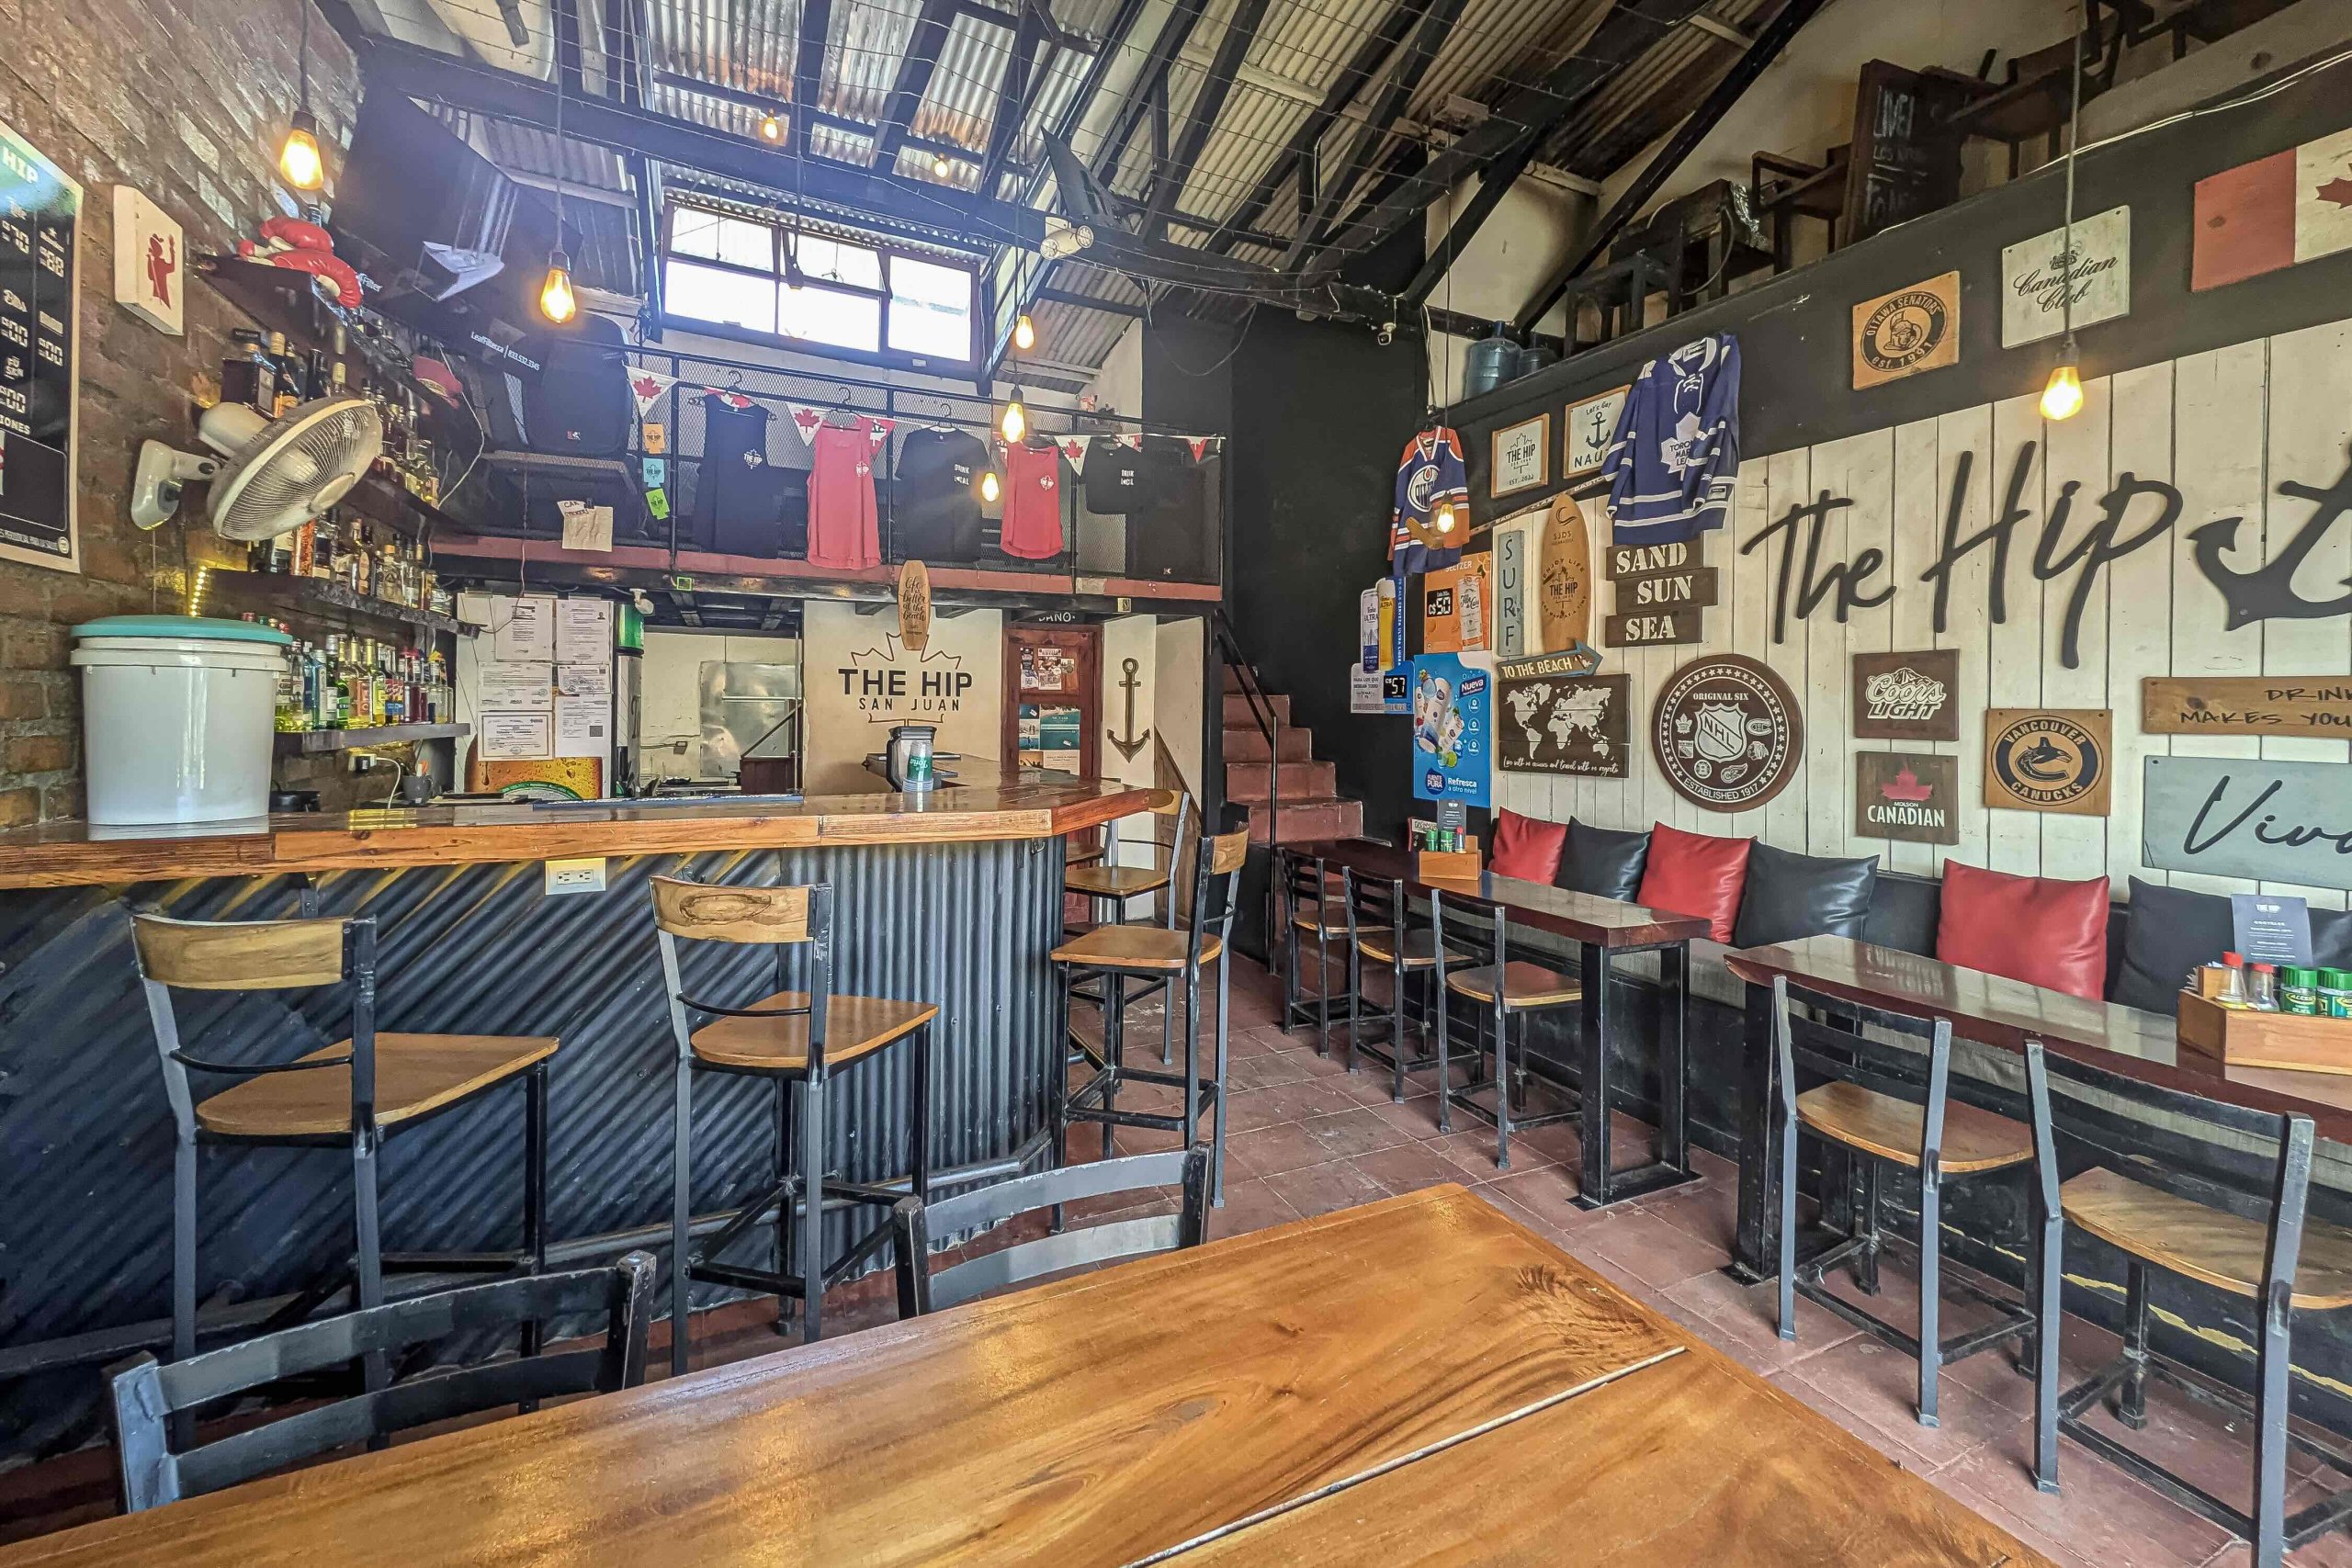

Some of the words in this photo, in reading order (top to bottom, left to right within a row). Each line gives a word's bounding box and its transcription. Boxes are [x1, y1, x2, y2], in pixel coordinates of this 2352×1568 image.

[2, 145, 39, 184] HIP
[2013, 256, 2118, 297] Canadian
[1866, 303, 1895, 336] OTTAWA
[1897, 295, 1942, 315] SENATORS
[1506, 448, 1521, 464] THE
[1523, 444, 1536, 458] HIP
[1669, 439, 1692, 452] TORO
[1574, 448, 1609, 468] NAU
[1574, 477, 1606, 491] EASTO
[1616, 542, 1688, 573] SAND
[1739, 489, 1897, 644] The
[1920, 440, 2183, 670] Hip
[1543, 558, 1565, 579] ENJOY
[1568, 558, 1585, 572] LIFE
[1502, 538, 1517, 647] SURF
[1549, 584, 1563, 597] THE
[1565, 581, 1578, 594] HIP
[1637, 575, 1693, 604] SUN
[1625, 615, 1676, 641] SEA
[1501, 665, 1515, 679] TO
[1516, 663, 1535, 677] THE
[1537, 657, 1573, 674] BEACH
[838, 668, 906, 696] THE
[922, 671, 972, 697] HIP
[1462, 679, 1484, 692] Nueva
[1865, 673, 1947, 703] Coors
[859, 697, 893, 710] SAN
[911, 698, 959, 711] JUAN
[1692, 693, 1733, 701] ORIGINAL
[1734, 693, 1749, 701] SIX
[1868, 701, 1942, 719] LIGHT
[2180, 711, 2283, 725] MAKES
[1703, 715, 1735, 750] NHL
[2004, 720, 2086, 745] VANCOUVER
[1428, 779, 1442, 788] PURA
[1447, 777, 1477, 787] Refresca
[1683, 778, 1739, 800] ESTABLISHED
[1740, 783, 1759, 796] 1917
[2011, 781, 2084, 801] CANUCKS
[1867, 805, 1945, 828] CANADIAN
